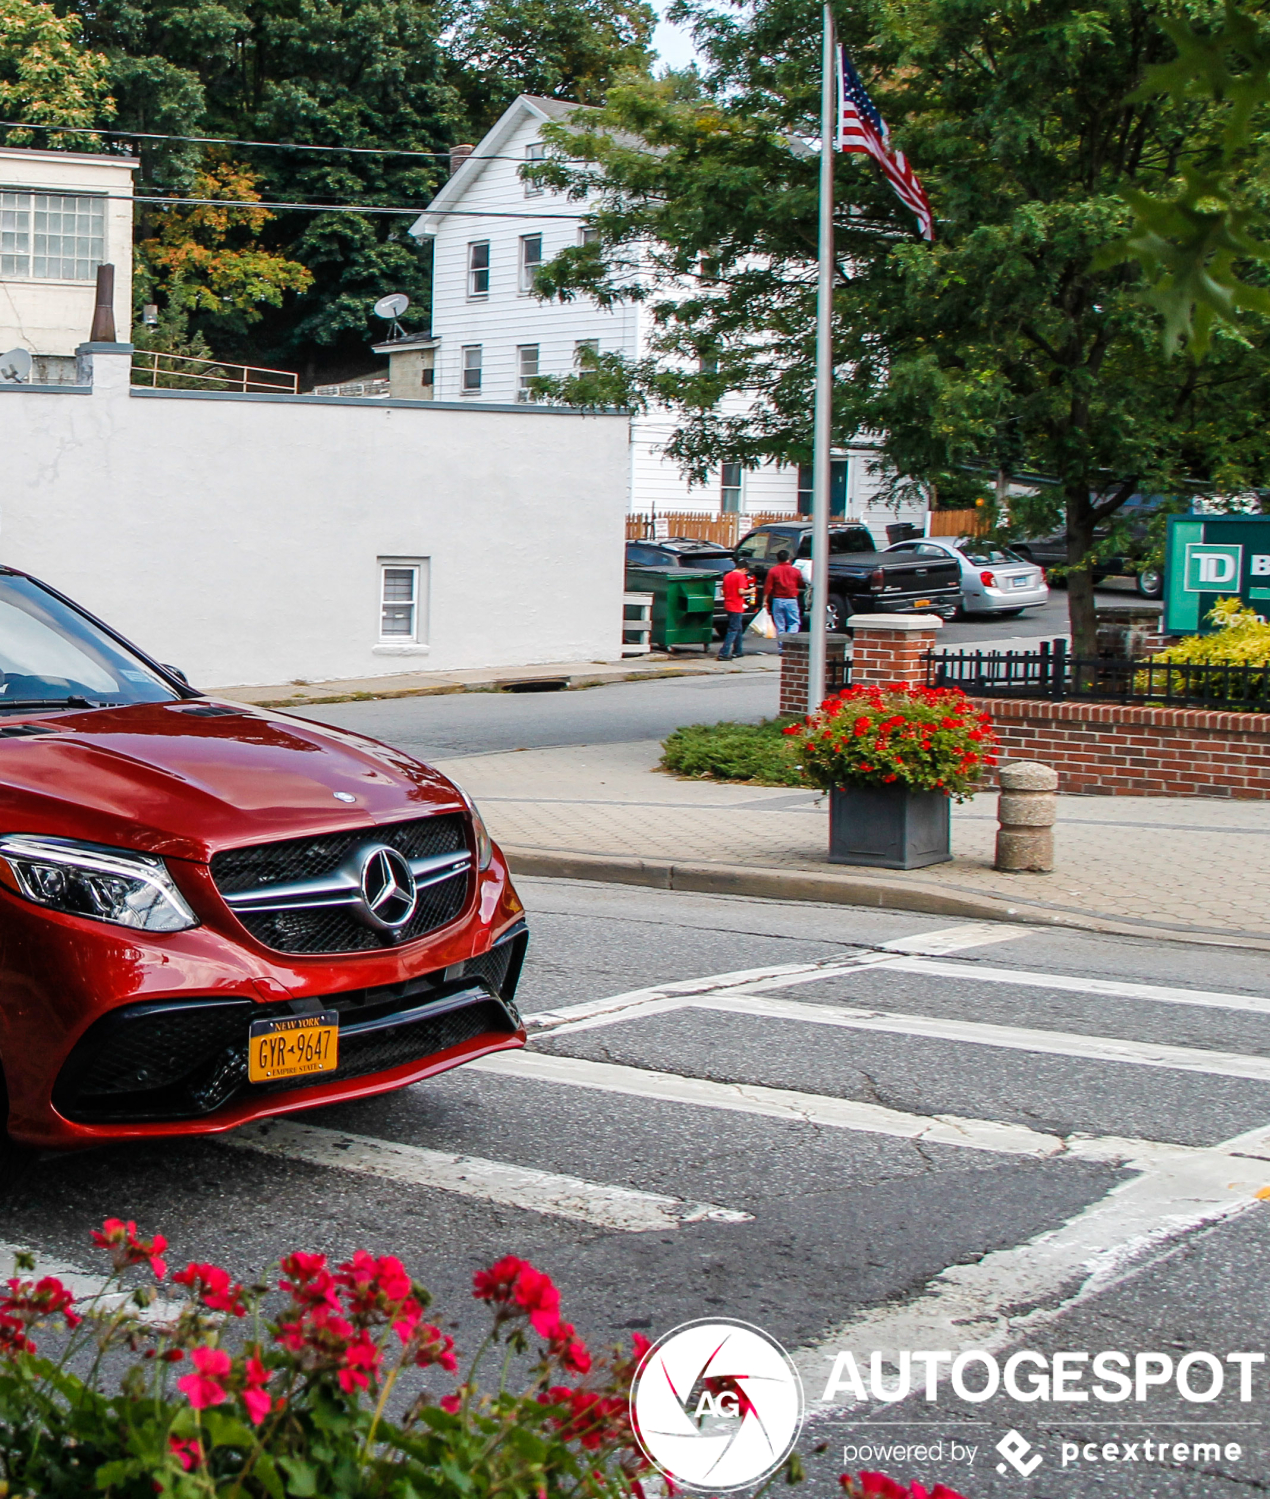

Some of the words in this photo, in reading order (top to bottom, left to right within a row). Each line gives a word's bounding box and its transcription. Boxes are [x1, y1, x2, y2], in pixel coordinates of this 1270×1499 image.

[1191, 552, 1236, 583] TD
[274, 1021, 297, 1031] NEW
[299, 1017, 320, 1028] YORK
[273, 1067, 297, 1076] EMPIRE
